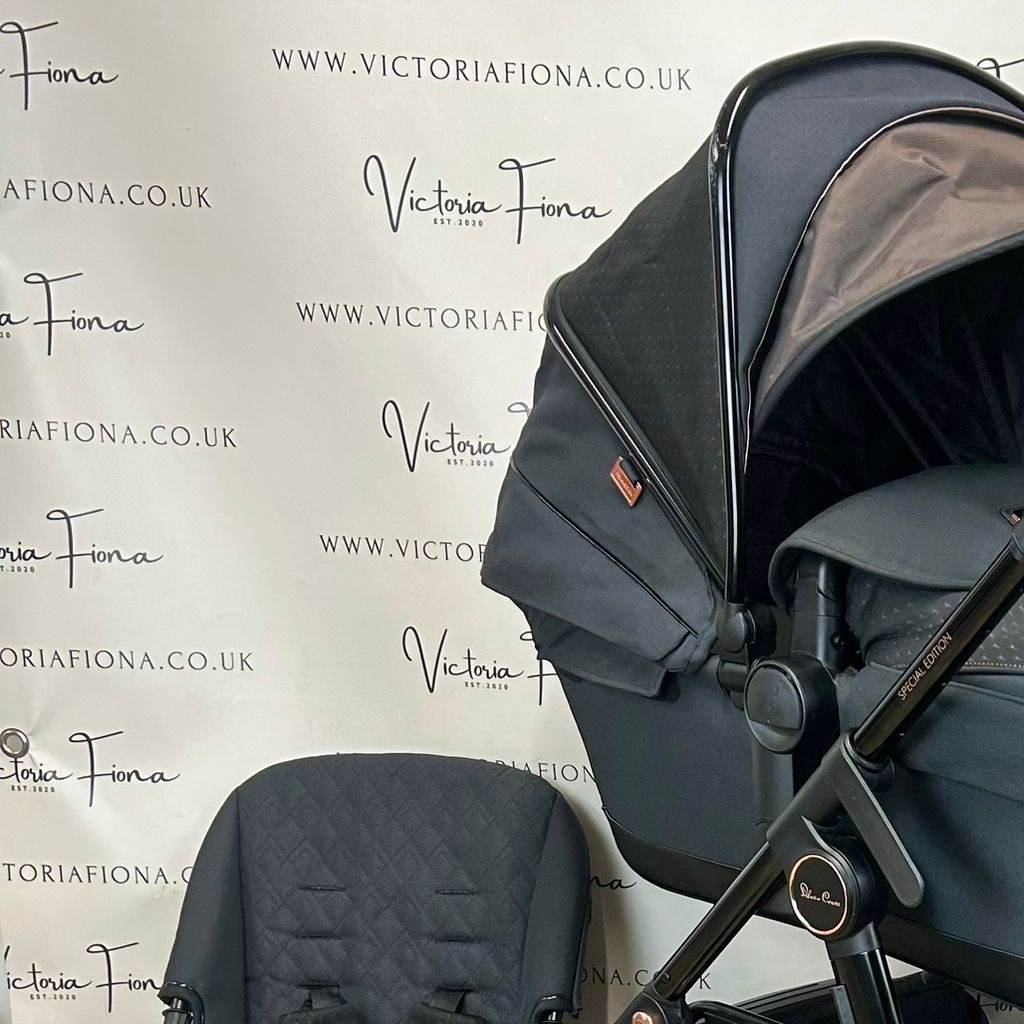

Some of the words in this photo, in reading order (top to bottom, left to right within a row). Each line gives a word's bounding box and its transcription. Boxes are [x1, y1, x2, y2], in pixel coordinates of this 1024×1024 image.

[272, 48, 692, 91] WWW.VICTORIAFIONA.CO.UK
[364, 154, 502, 233] Victoria
[499, 157, 613, 245] Fiona
[433, 217, 484, 228] EST.2020
[24, 272, 145, 357] Fiona
[382, 399, 511, 473] Victoria
[47, 508, 164, 589] Fiona
[402, 625, 524, 694] Victoria
[897, 667, 926, 701] SPECIAL
[922, 632, 953, 670] EDITION
[69, 730, 181, 808] Fiona
